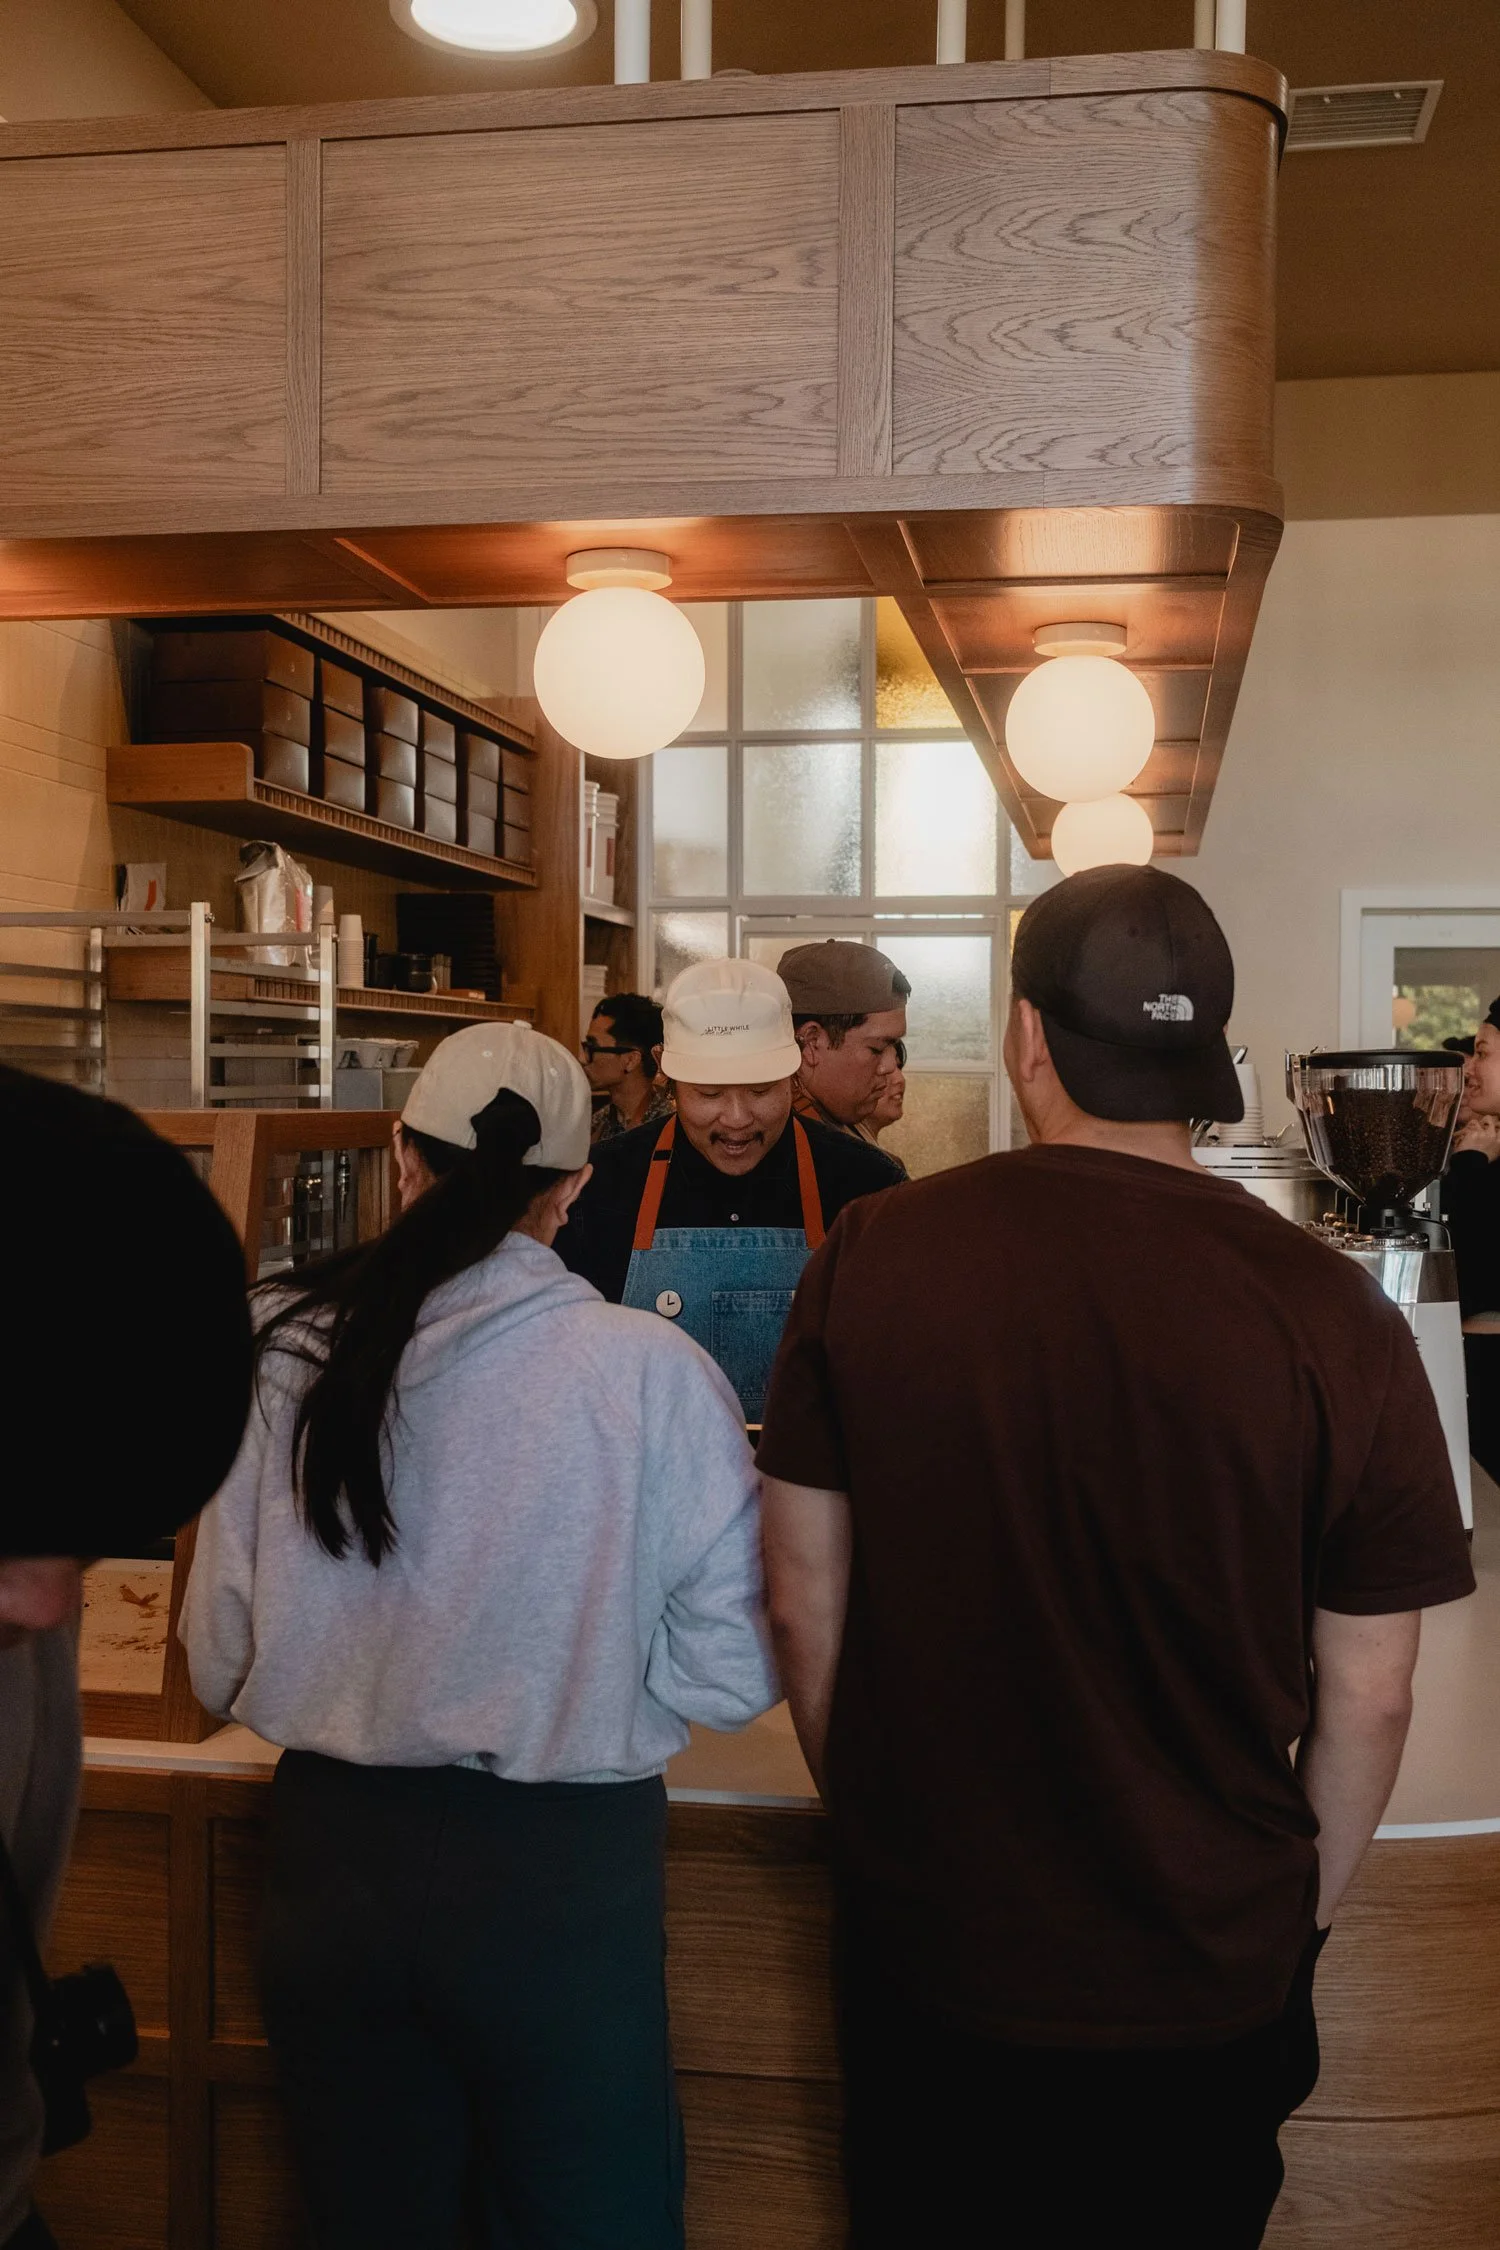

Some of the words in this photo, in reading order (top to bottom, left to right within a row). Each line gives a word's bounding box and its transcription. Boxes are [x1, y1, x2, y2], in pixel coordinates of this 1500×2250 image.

[1158, 994, 1177, 1004] THE
[1143, 1001, 1177, 1012] NORTH
[1151, 1011, 1177, 1021] FACE
